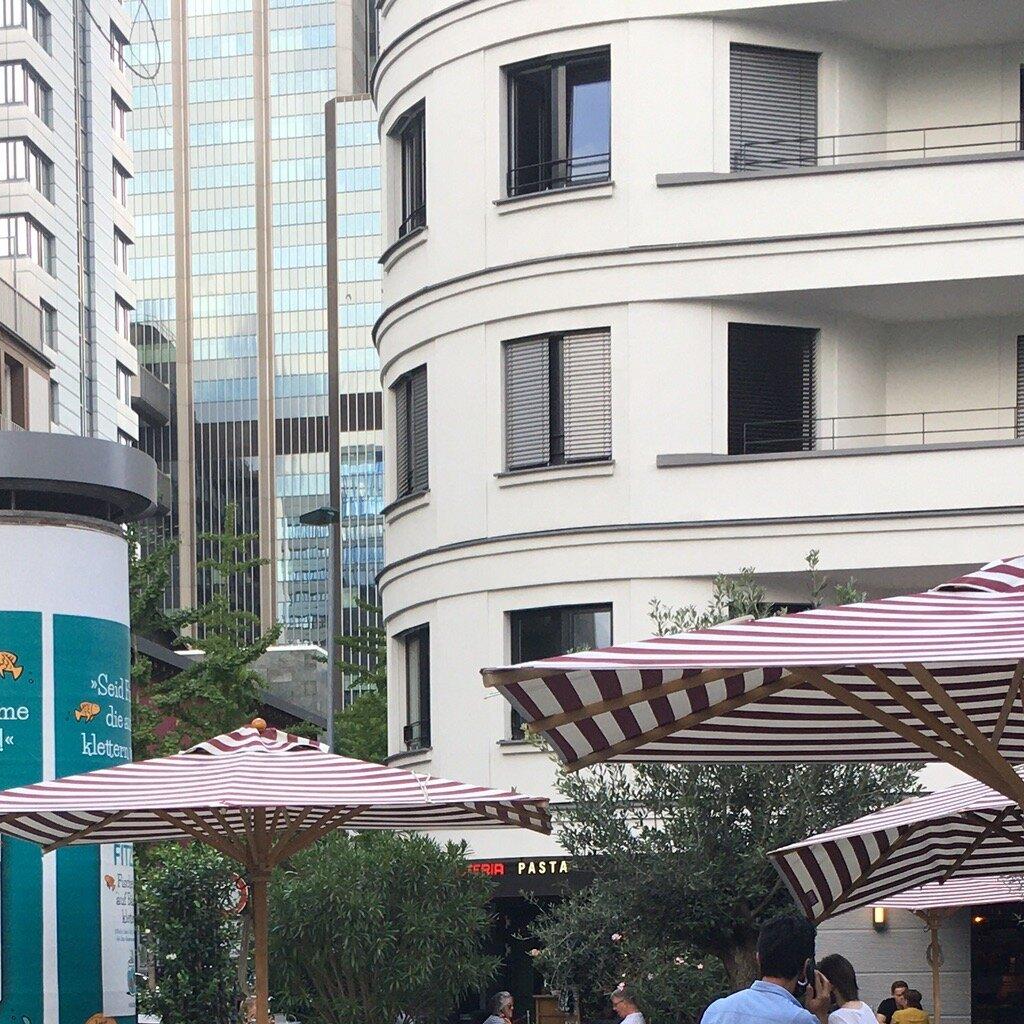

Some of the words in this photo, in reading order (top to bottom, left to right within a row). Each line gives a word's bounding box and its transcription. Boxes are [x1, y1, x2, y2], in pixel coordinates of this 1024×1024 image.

[106, 705, 124, 728] die
[81, 732, 130, 760] klettern
[518, 861, 568, 875] PASTA
